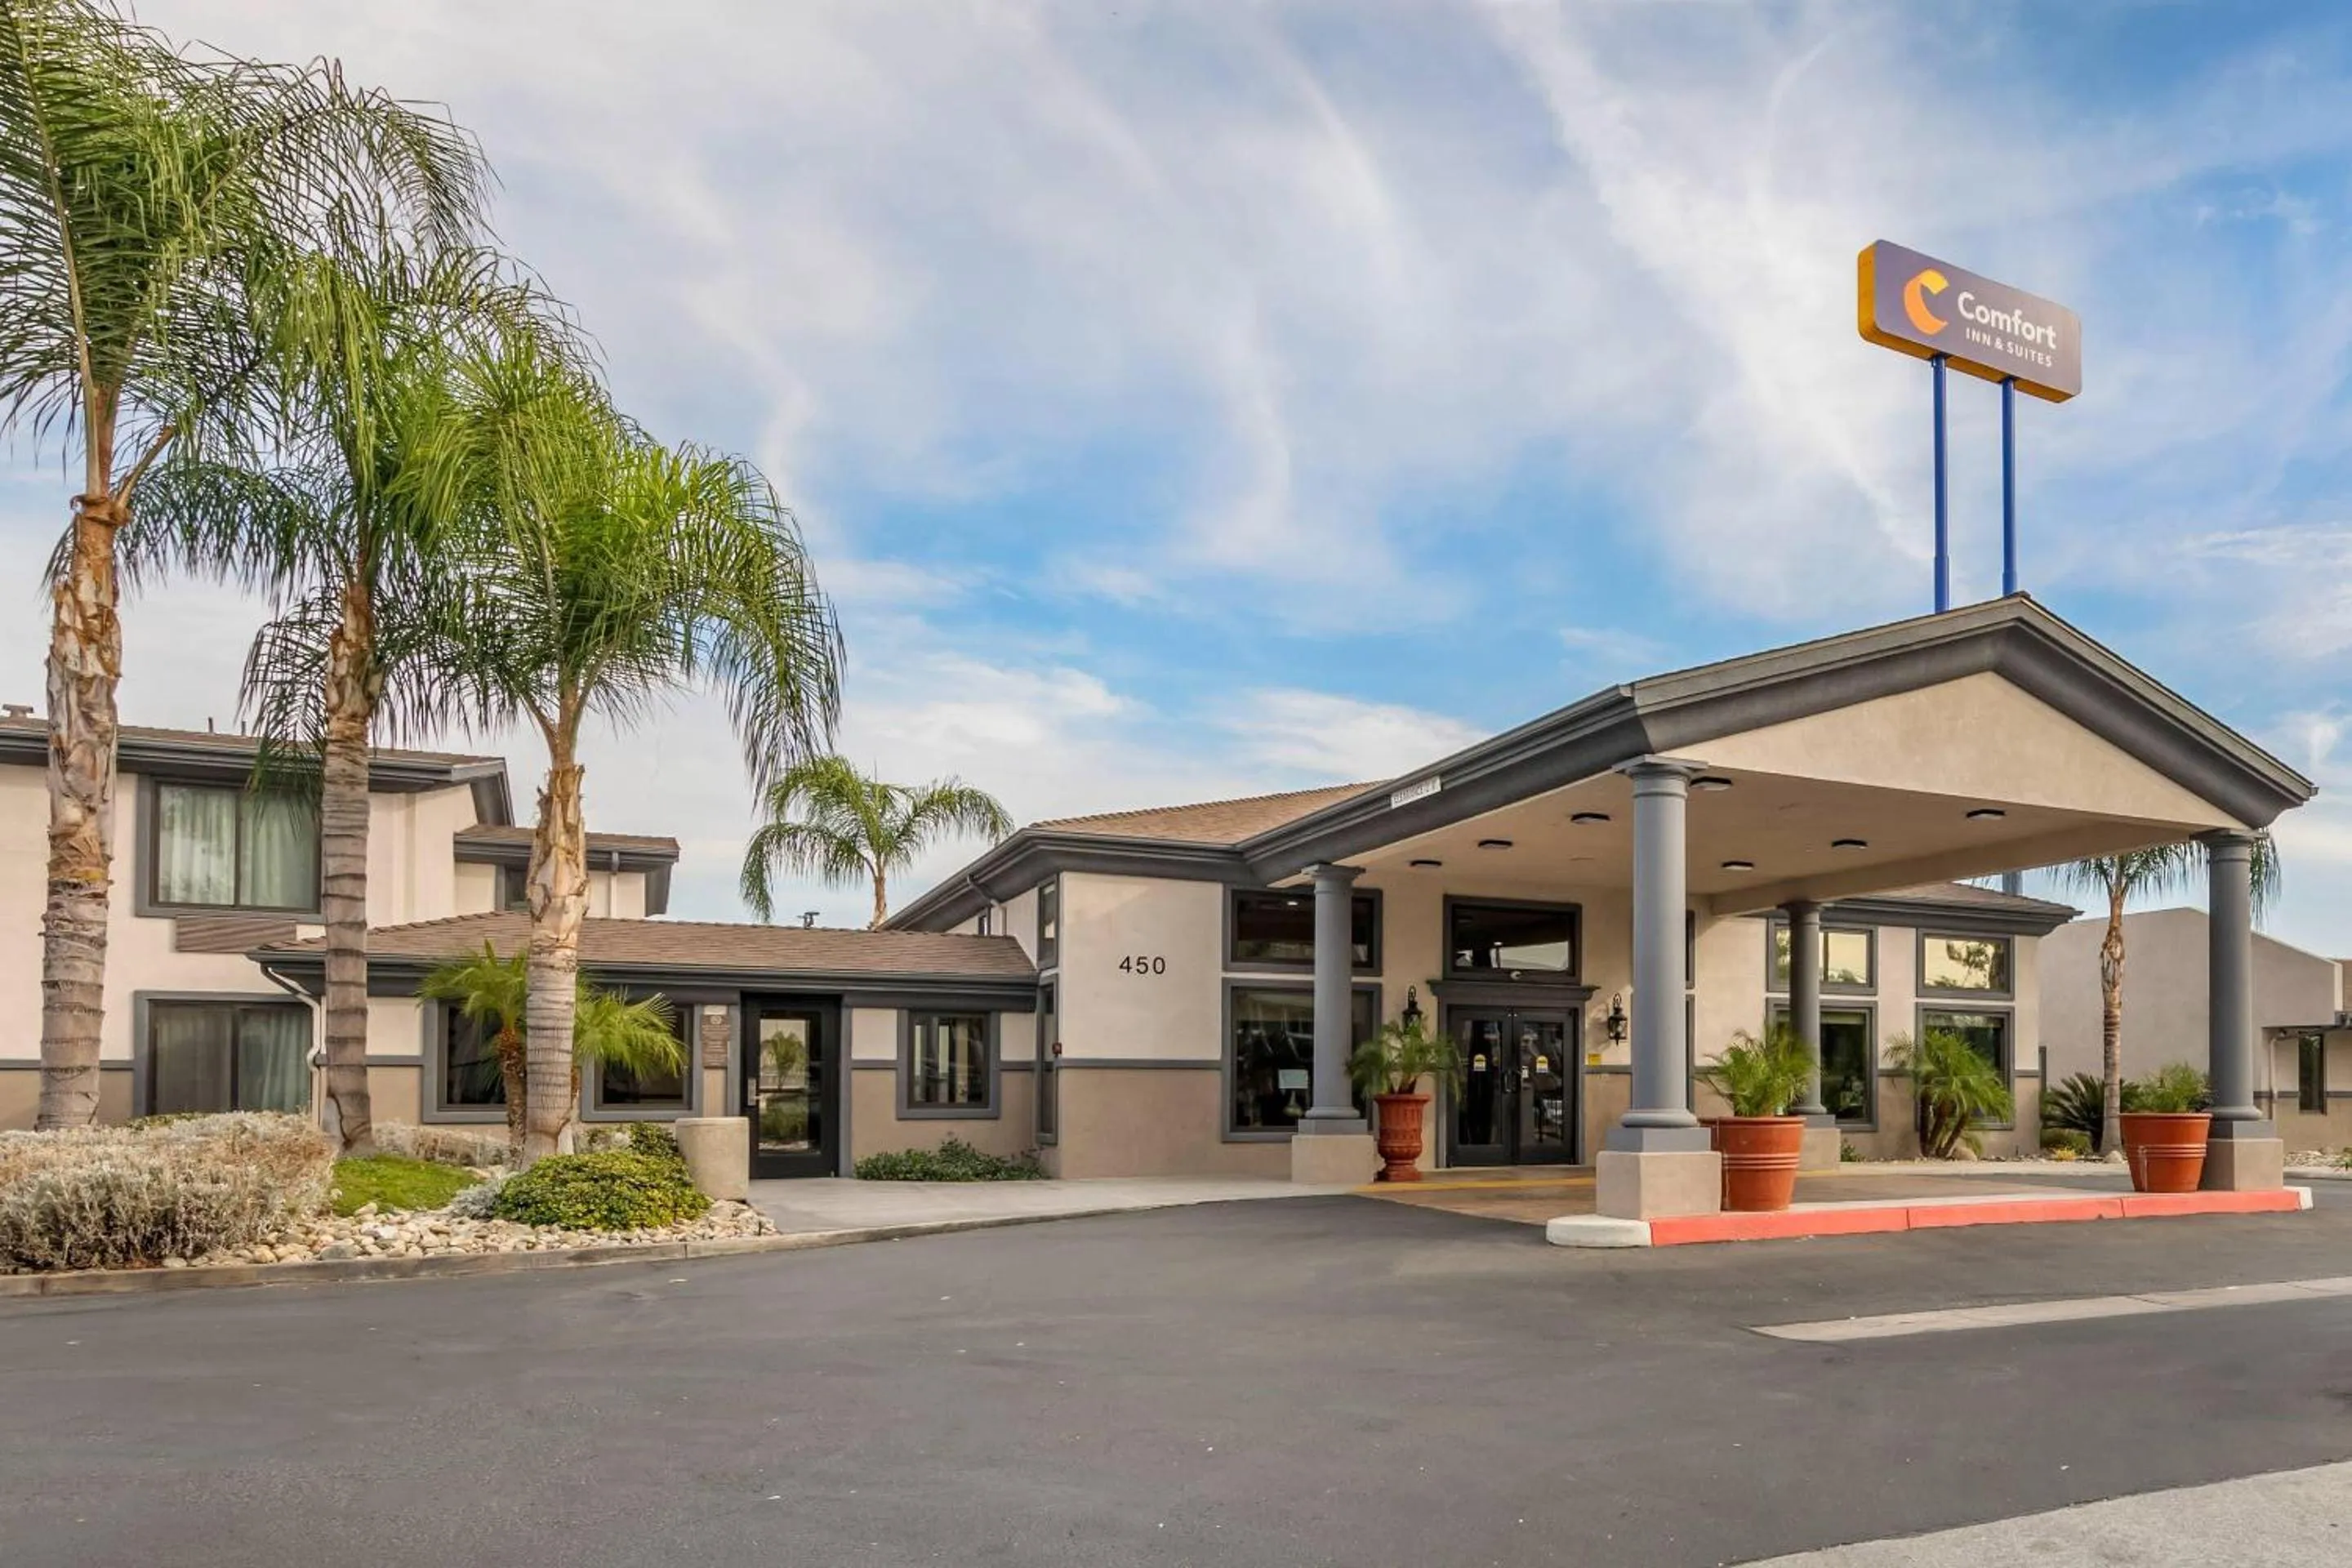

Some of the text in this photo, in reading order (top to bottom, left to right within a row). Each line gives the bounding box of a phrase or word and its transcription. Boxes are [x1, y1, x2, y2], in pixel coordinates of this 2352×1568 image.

[1958, 292, 2056, 350] Comfort
[1966, 327, 2051, 368] INN & SUITES
[1119, 956, 1165, 974] 450
